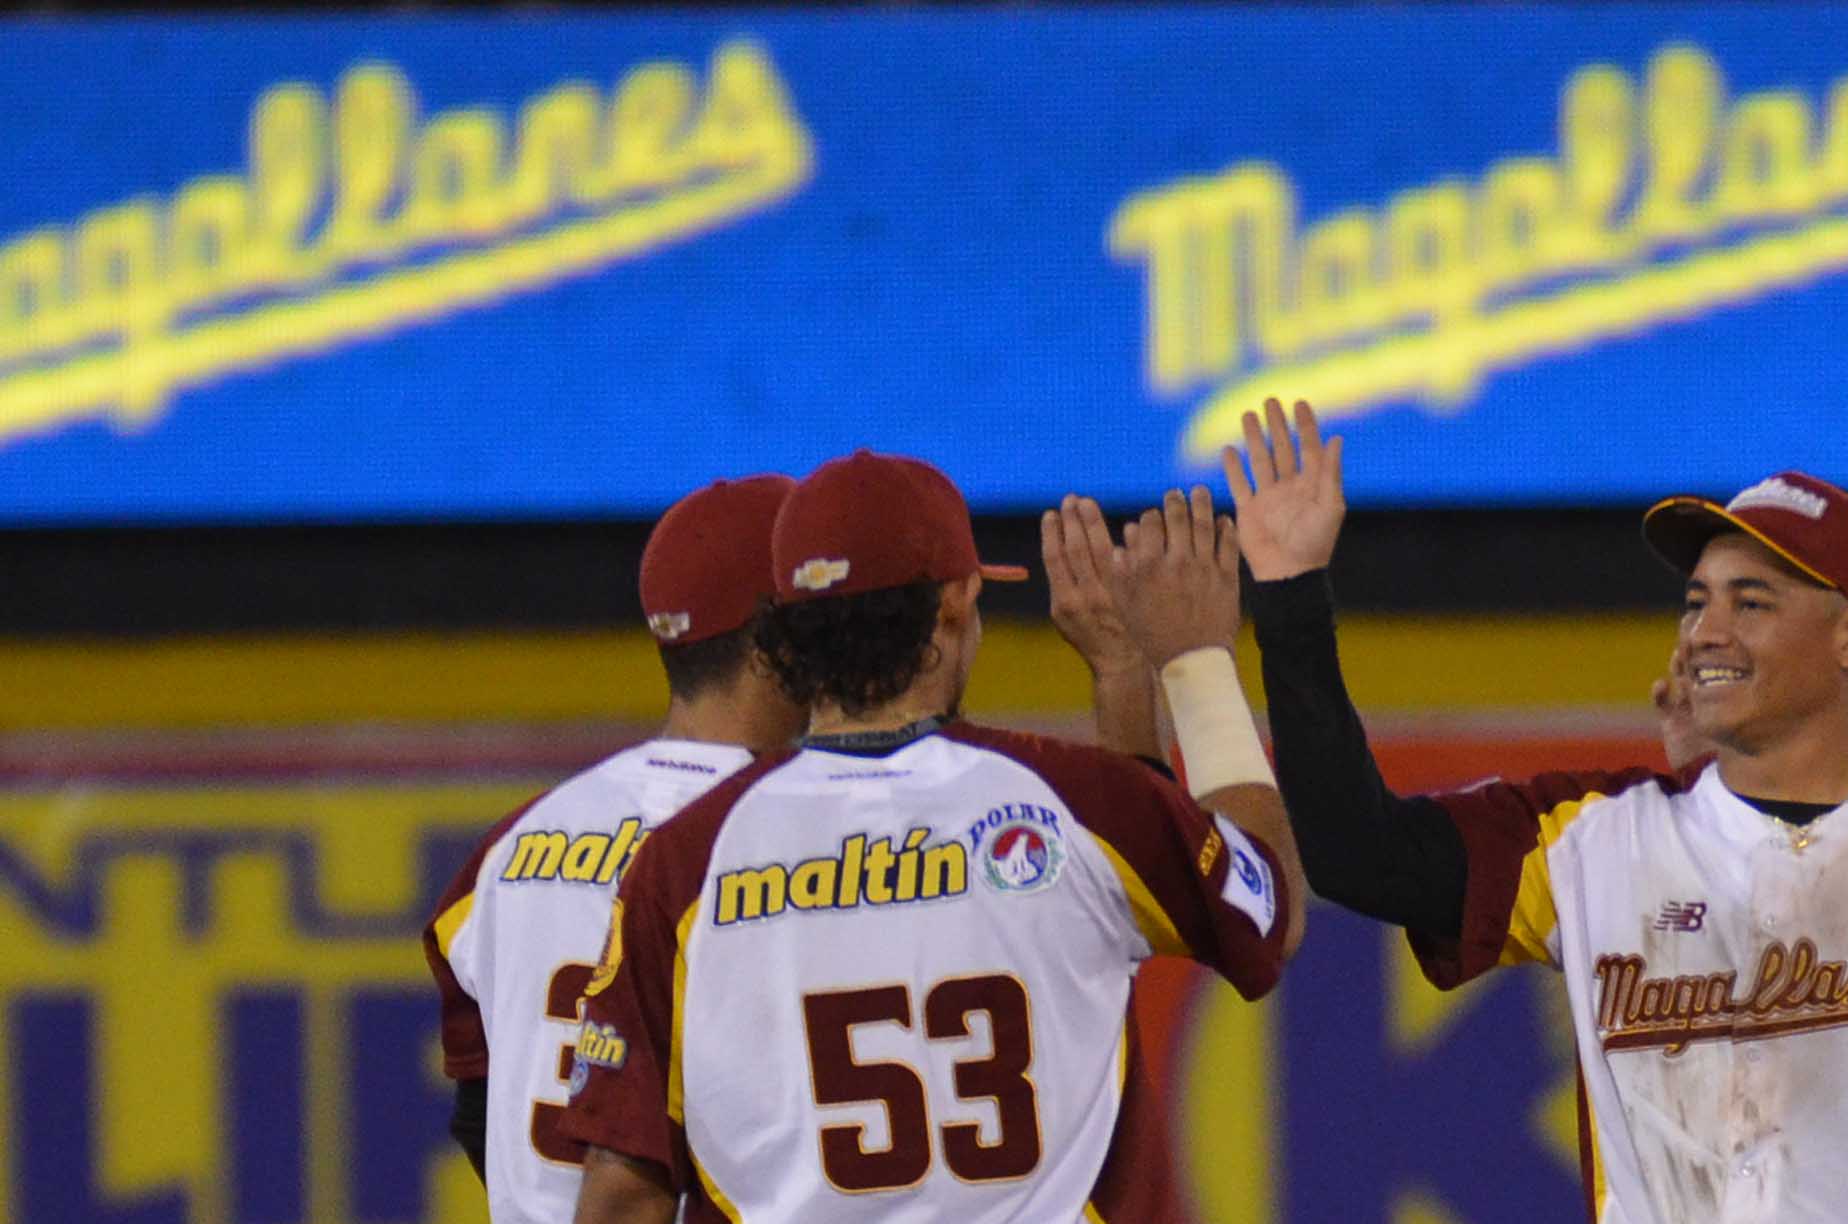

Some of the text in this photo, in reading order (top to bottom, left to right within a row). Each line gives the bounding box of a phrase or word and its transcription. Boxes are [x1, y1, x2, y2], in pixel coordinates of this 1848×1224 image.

[714, 827, 967, 926] maltín
[968, 803, 1062, 853] POLAR
[802, 971, 1044, 1195] 53
